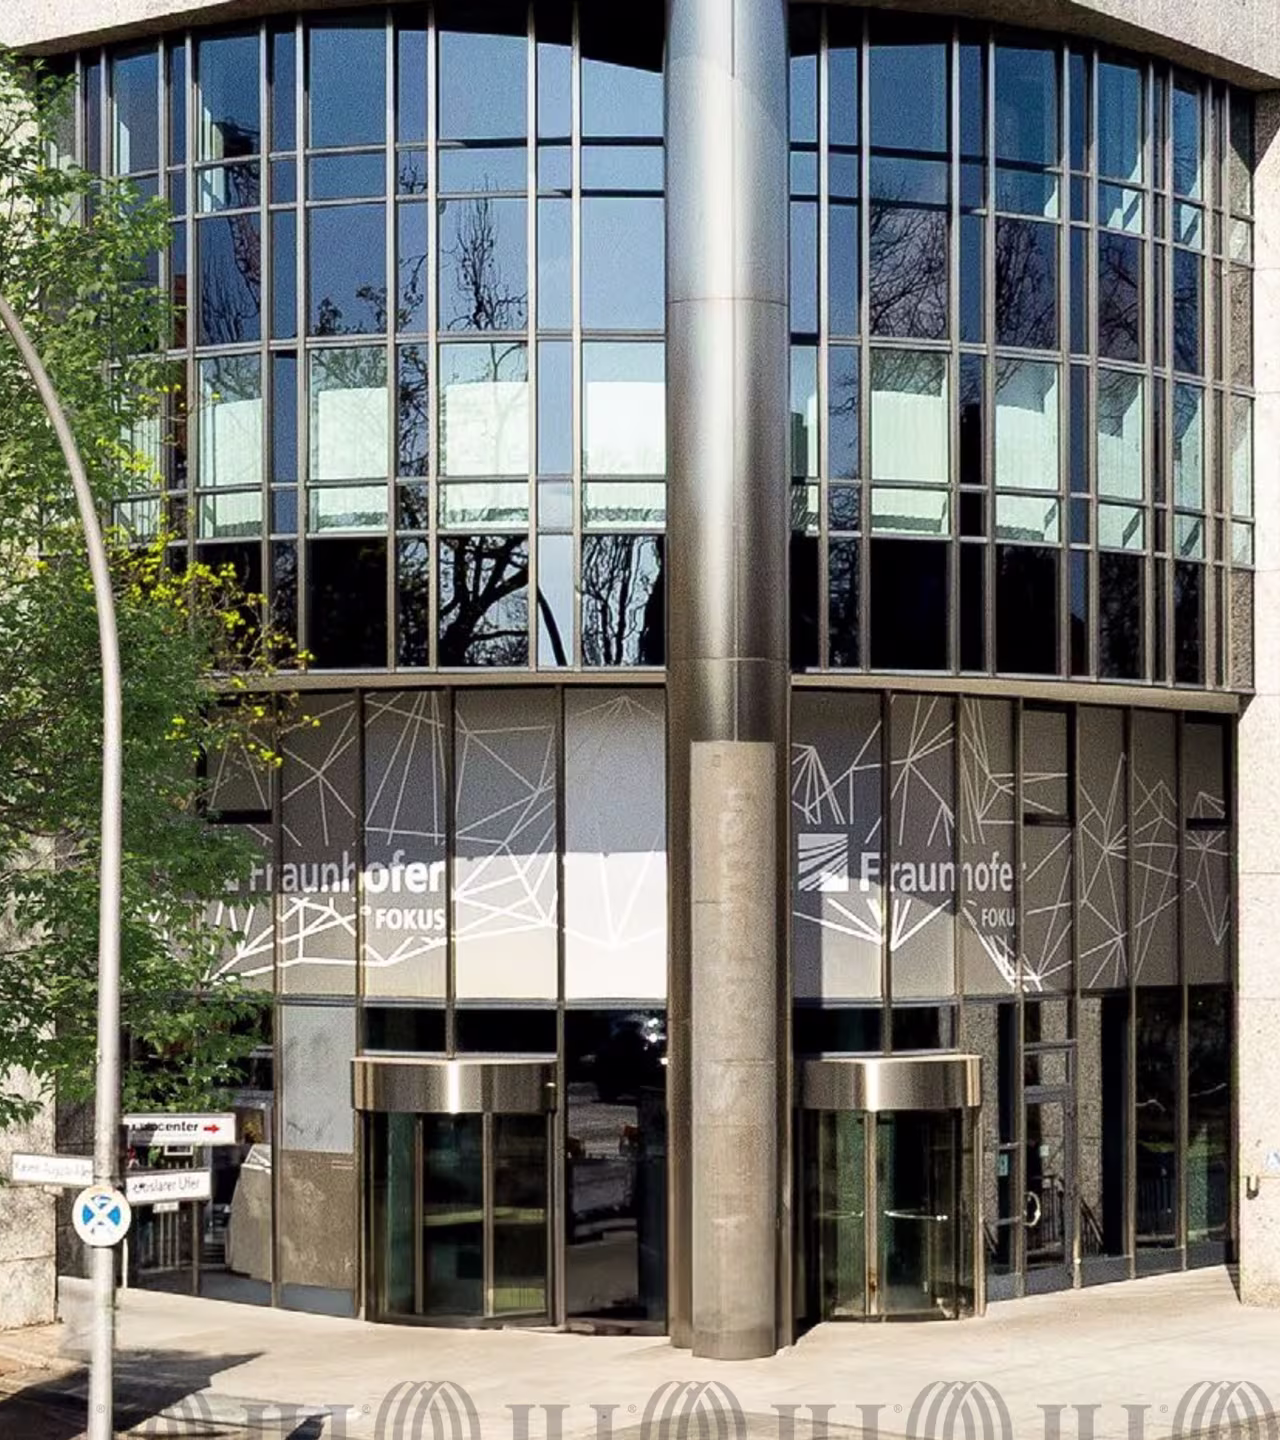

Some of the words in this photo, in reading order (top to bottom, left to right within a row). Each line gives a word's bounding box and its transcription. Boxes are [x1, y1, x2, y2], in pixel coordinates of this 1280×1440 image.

[859, 850, 1026, 893] Fraunofe
[376, 907, 446, 931] FOKUS
[981, 908, 1016, 928] FOKU
